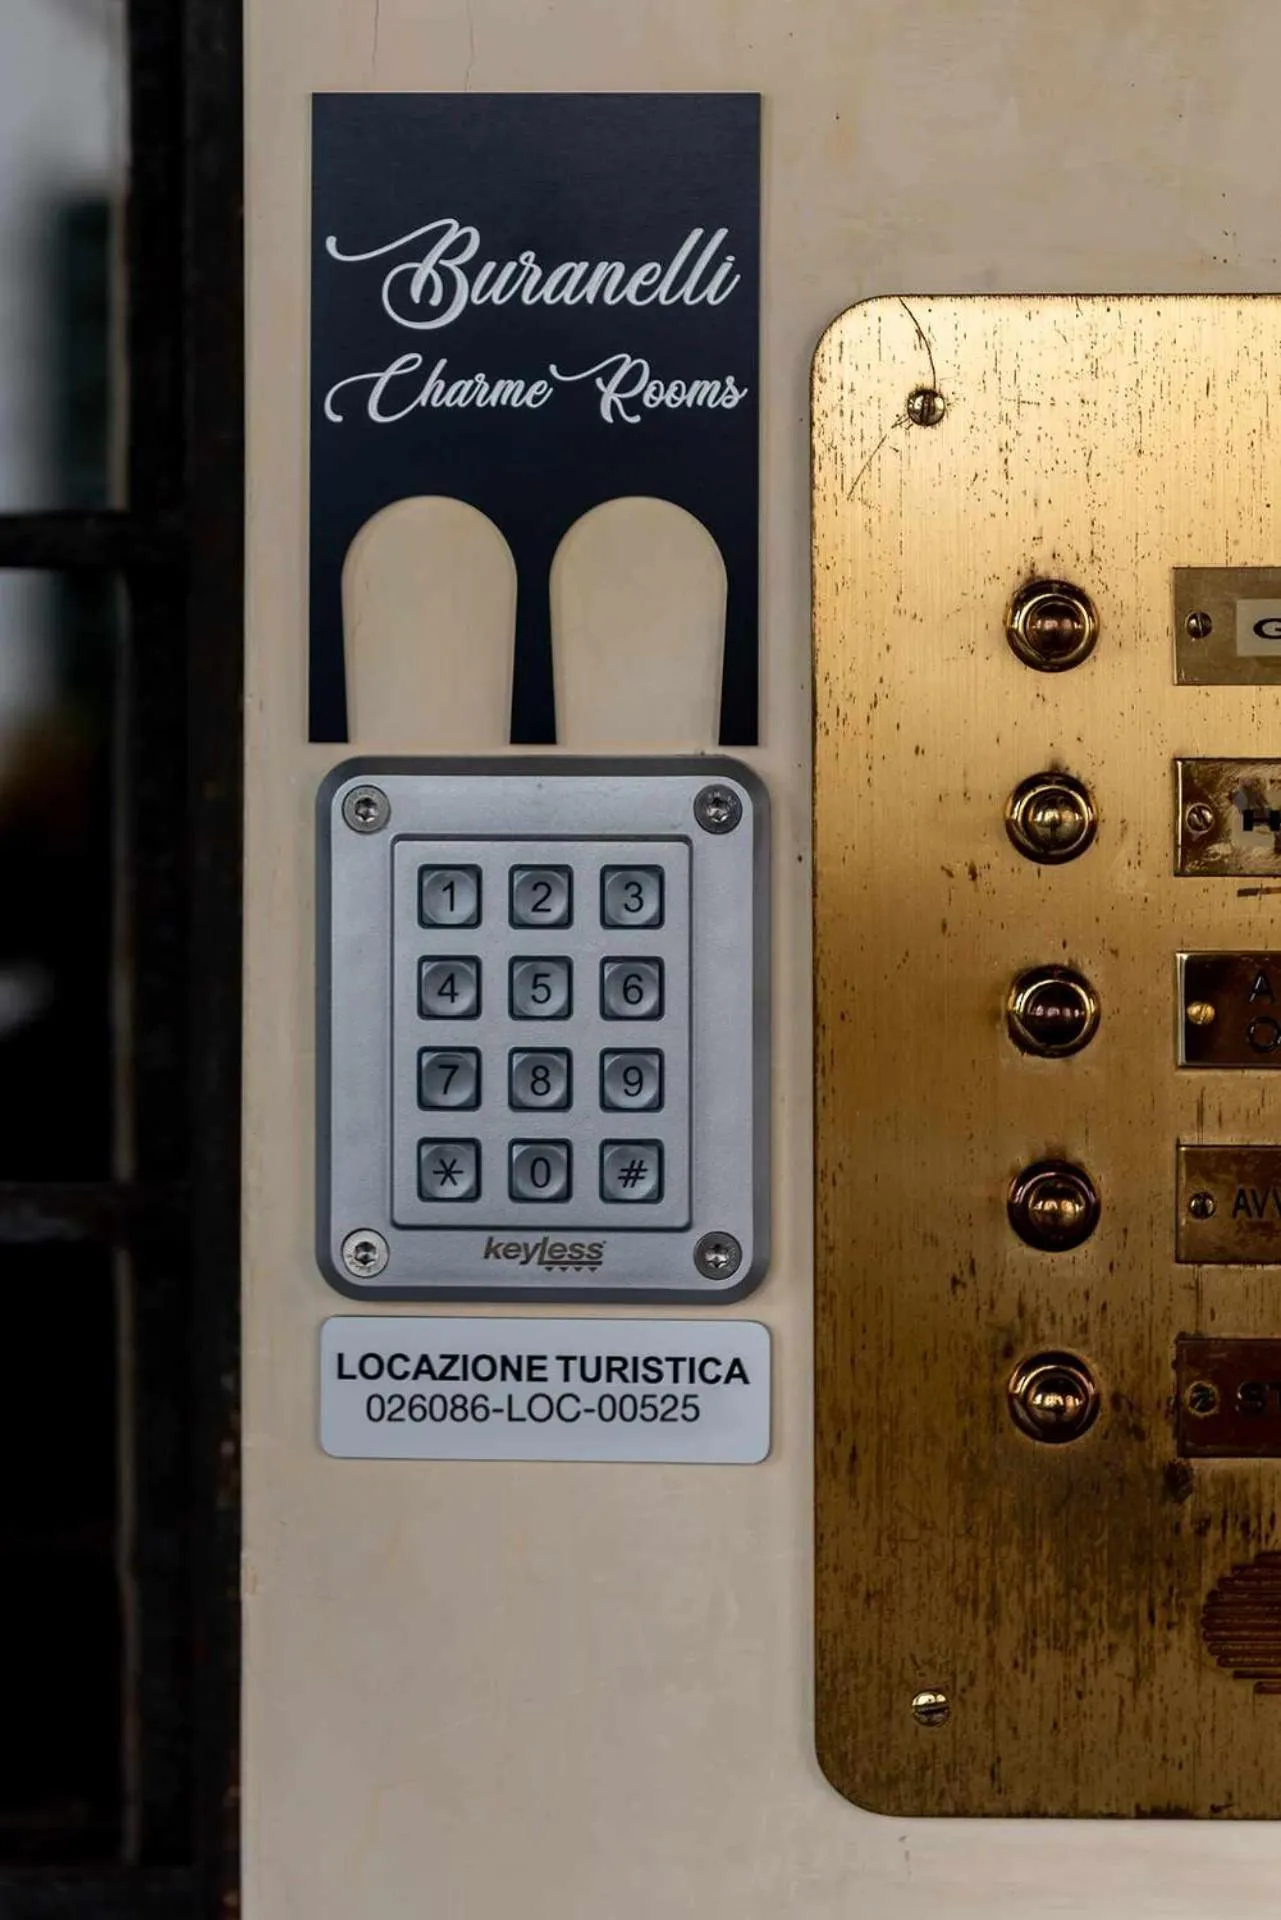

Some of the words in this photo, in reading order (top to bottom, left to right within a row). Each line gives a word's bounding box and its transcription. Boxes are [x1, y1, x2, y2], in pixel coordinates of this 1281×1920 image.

[326, 218, 740, 330] Buranelli
[325, 353, 552, 423] Charme
[549, 353, 748, 423] Rooms
[442, 881, 455, 912] 1
[531, 881, 552, 912] 2
[623, 881, 644, 913] 3
[437, 973, 459, 1003] 4
[531, 973, 551, 1004] 5
[622, 974, 643, 1005] 6
[438, 1064, 459, 1095] 7
[530, 1065, 551, 1096] 8
[622, 1066, 643, 1097] 9
[530, 1157, 551, 1188] 0
[618, 1159, 648, 1188] #
[337, 1353, 548, 1383] LOCAZIONE
[556, 1355, 750, 1385] TURISTICA
[366, 1393, 700, 1423] 026086-LOC-00525
